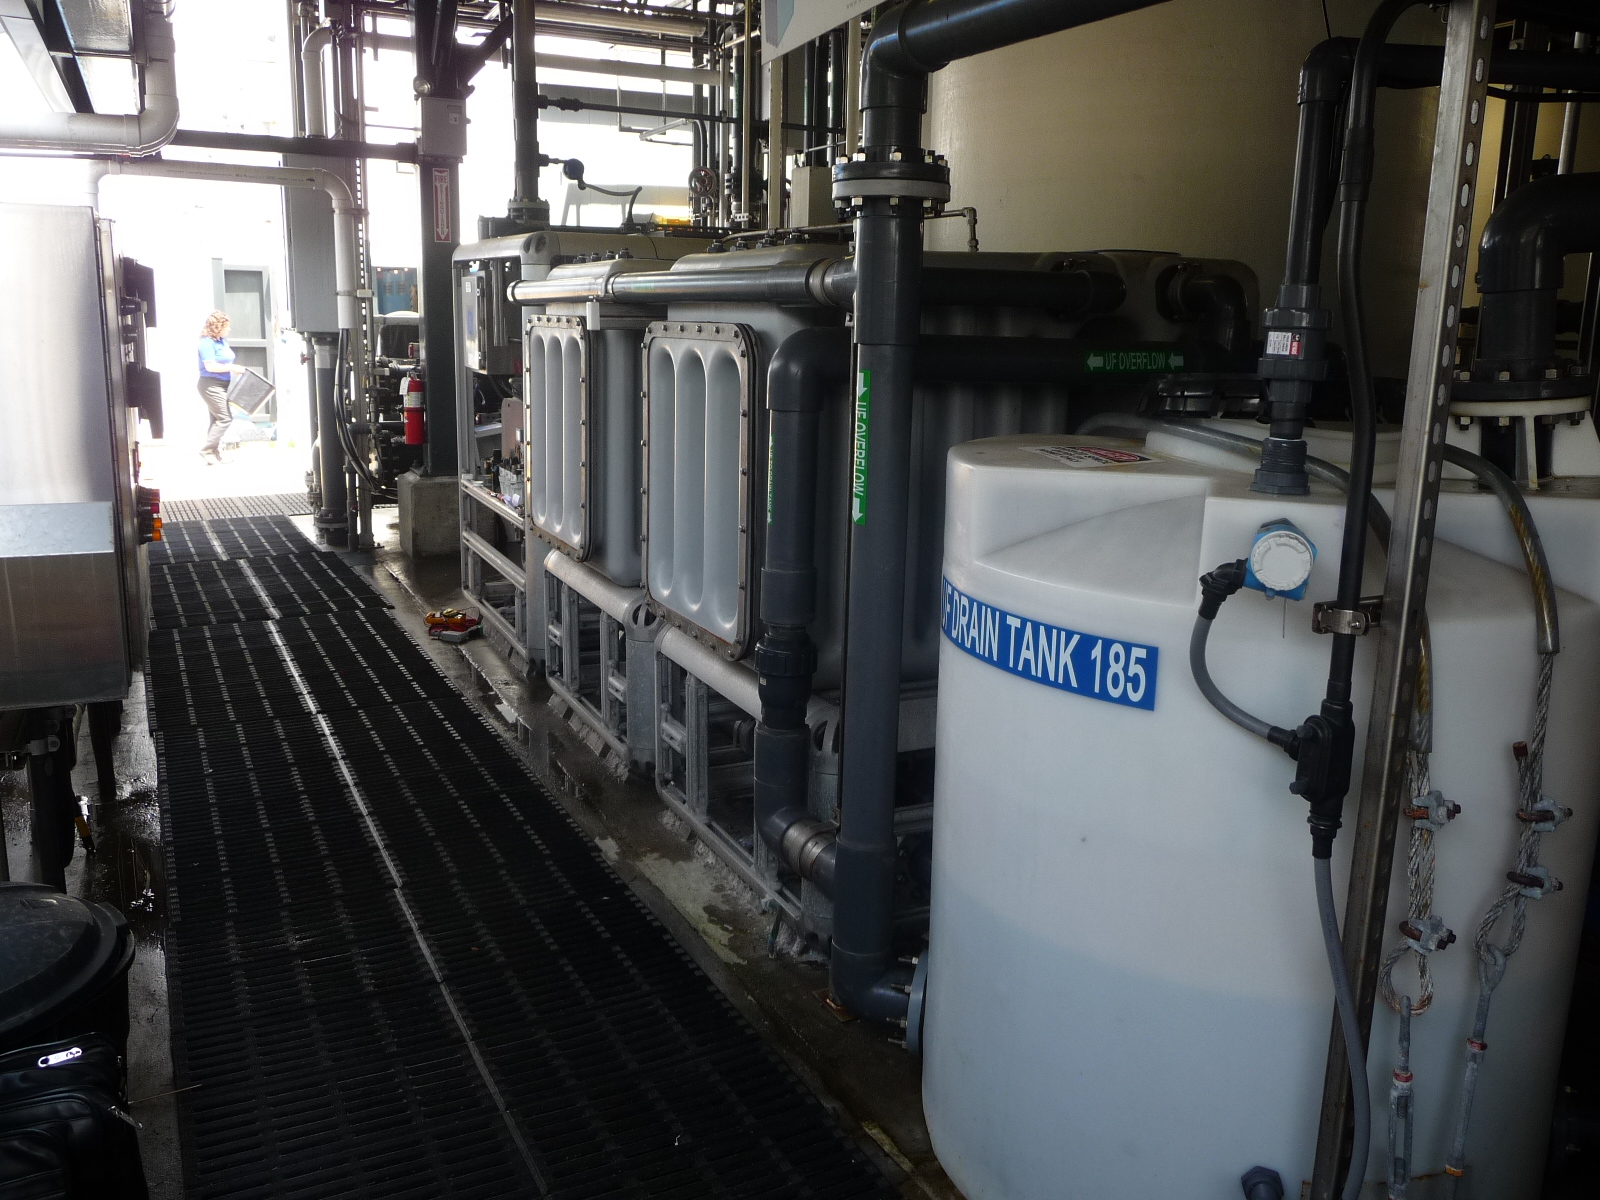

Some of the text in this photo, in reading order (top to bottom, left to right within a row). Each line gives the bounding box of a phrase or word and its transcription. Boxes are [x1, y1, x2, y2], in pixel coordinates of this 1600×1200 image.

[1105, 352, 1166, 370] UF OVERFLOW
[951, 590, 1000, 662] DRAIN
[1006, 614, 1081, 688] TANK
[1091, 639, 1147, 702] 185
